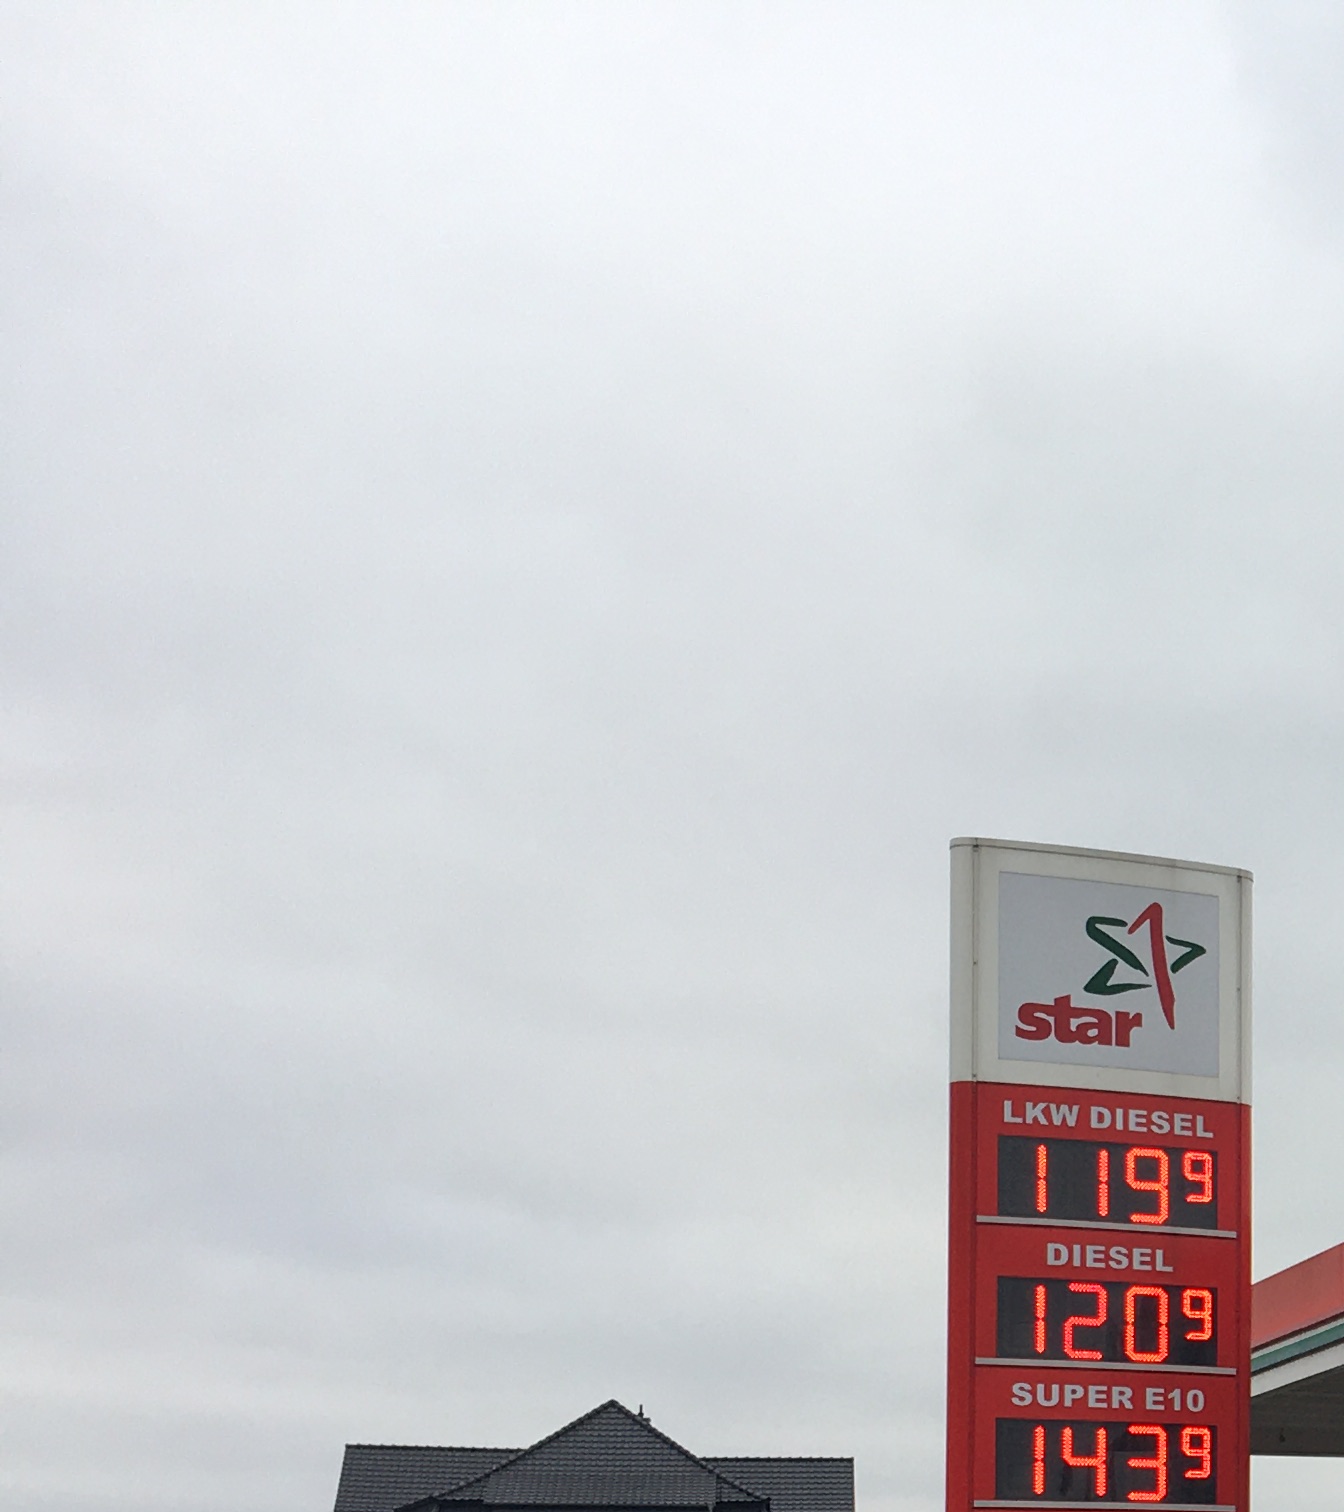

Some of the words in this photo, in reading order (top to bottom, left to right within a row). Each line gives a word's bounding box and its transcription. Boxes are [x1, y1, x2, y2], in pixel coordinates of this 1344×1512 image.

[1015, 995, 1142, 1048] star
[1003, 1100, 1080, 1127] LKW
[1090, 1106, 1214, 1138] DIESEL
[1046, 1243, 1173, 1272] DIESEL
[1011, 1382, 1133, 1410] SUPER
[1145, 1387, 1205, 1412] E10
